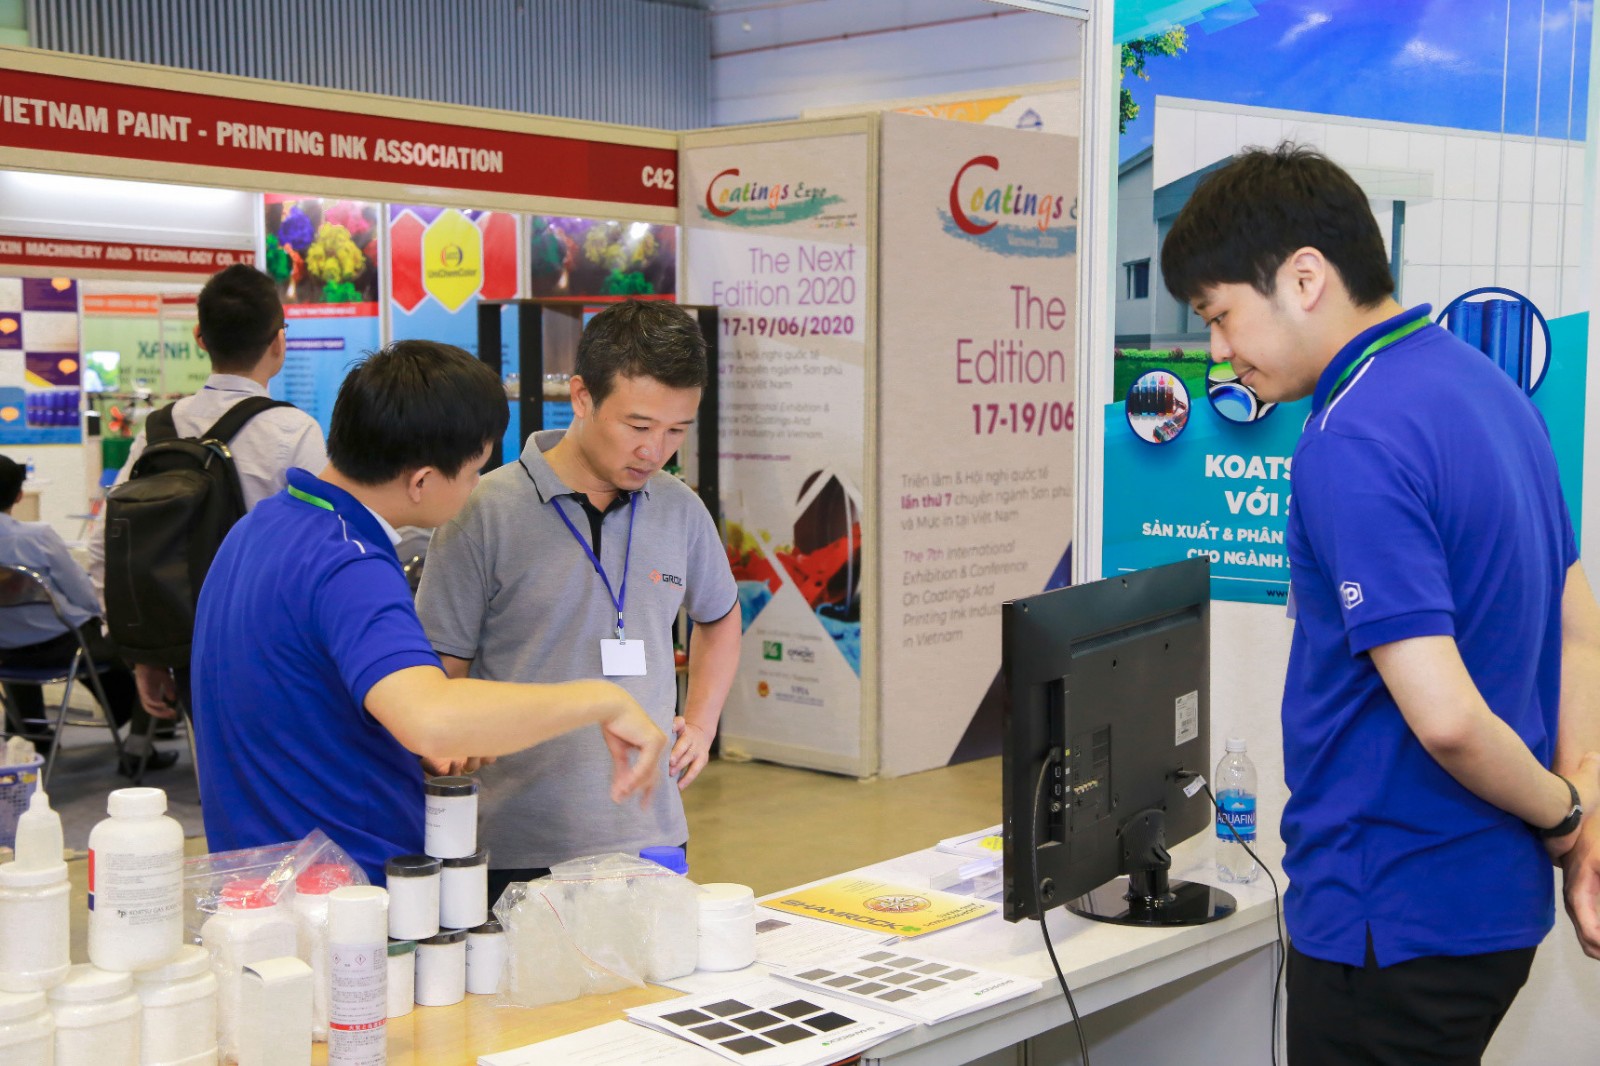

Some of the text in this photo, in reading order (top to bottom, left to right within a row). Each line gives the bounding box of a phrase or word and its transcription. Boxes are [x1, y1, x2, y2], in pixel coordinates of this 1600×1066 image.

[0, 94, 503, 173] IETNAM PAINT - PRINTING INK ASSOCIATION
[641, 166, 675, 190] C42
[706, 168, 789, 218] Coatings
[949, 155, 1063, 235] Coatings
[26, 242, 103, 260] MACHINERY
[106, 247, 132, 261] AND
[136, 247, 214, 265] TECHNOLOGY
[749, 243, 856, 274] The Next
[712, 276, 856, 307] Edition 2020
[1010, 285, 1066, 331] The
[722, 316, 855, 338] 17-19/06/2020
[957, 338, 1065, 384] Edition
[944, 493, 952, 507] 7
[1224, 486, 1278, 516] VỚI
[1142, 519, 1284, 544] SẢN XUẤT & PHÂN
[903, 550, 923, 563] The
[947, 540, 1016, 561] International
[1224, 550, 1283, 568] NGÀNH
[903, 560, 1029, 586] Exhibition & Conference
[903, 583, 995, 607] On Coatings And
[903, 610, 947, 628] Printing
[950, 606, 966, 619] Ink
[916, 629, 963, 646] Vietnam
[780, 899, 904, 931] SHAMROCK
